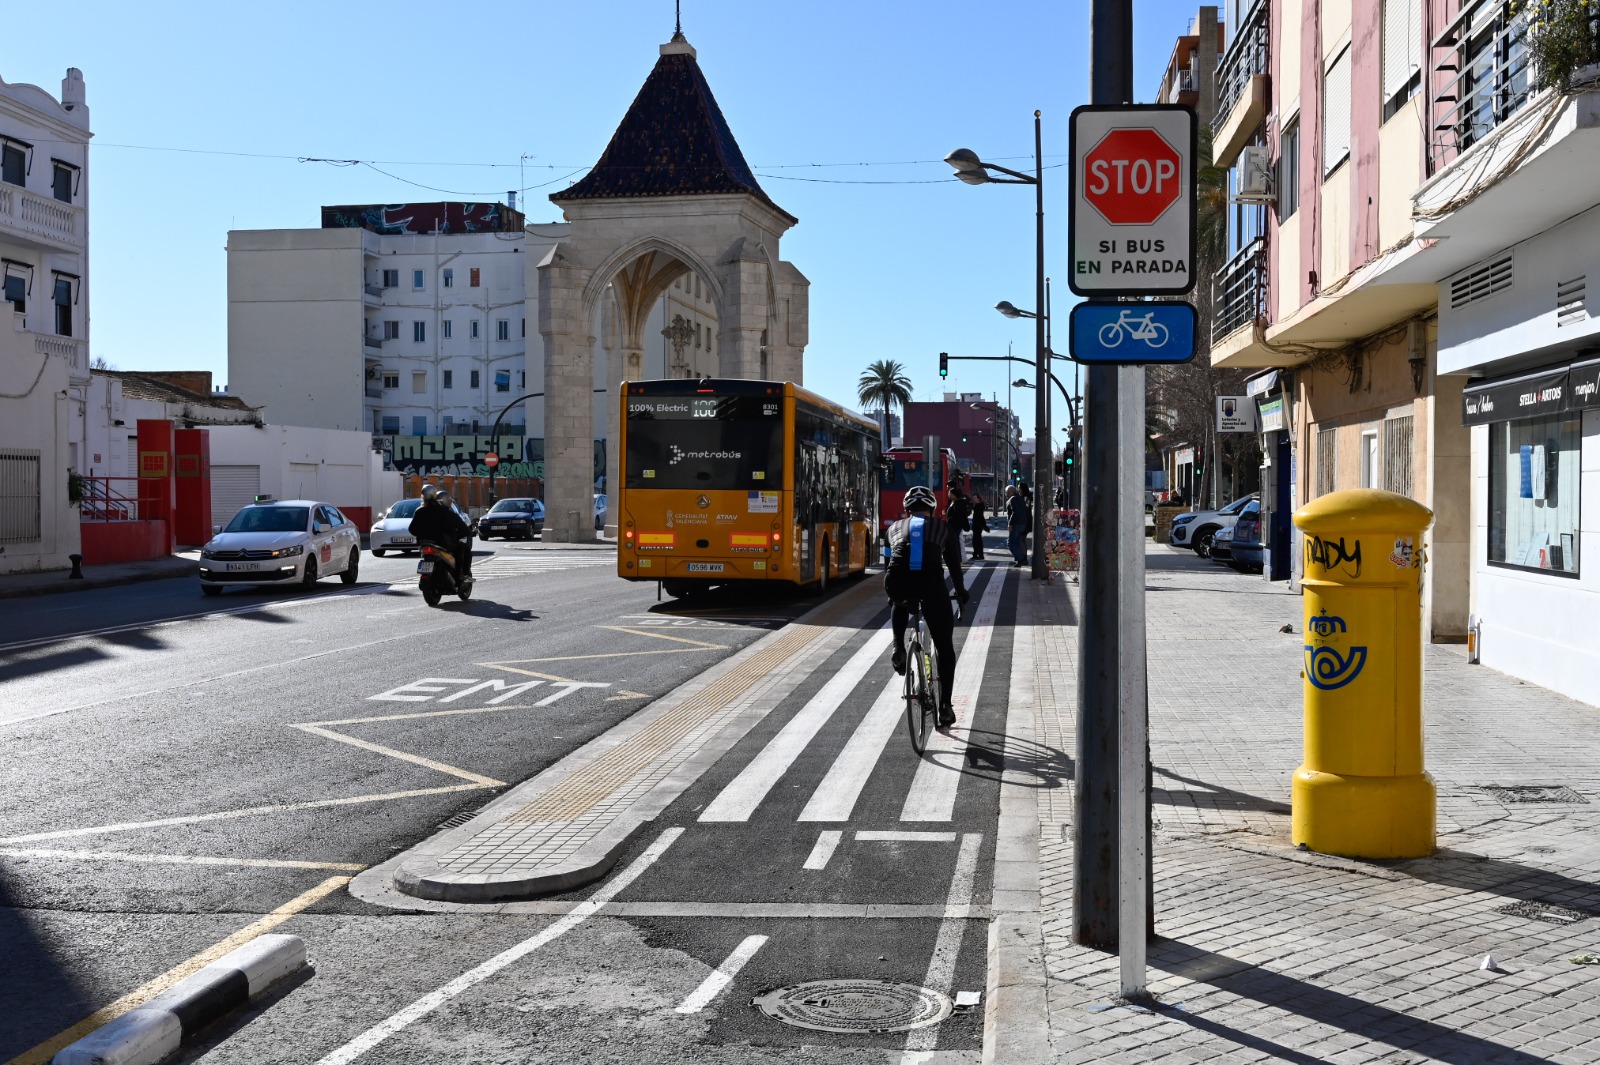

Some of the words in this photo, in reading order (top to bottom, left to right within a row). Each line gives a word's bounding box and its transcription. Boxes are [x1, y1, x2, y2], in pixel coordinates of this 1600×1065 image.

[1089, 159, 1176, 195] STOP
[1099, 240, 1116, 253] SI
[1127, 239, 1165, 253] BUS
[1076, 260, 1101, 274] EN
[1111, 260, 1187, 274] PARADA
[1519, 394, 1537, 406] STELLA
[1541, 386, 1562, 402] ARTOIS
[687, 450, 742, 459] metrobús
[691, 563, 708, 571] 0596
[365, 677, 613, 707] EMT
